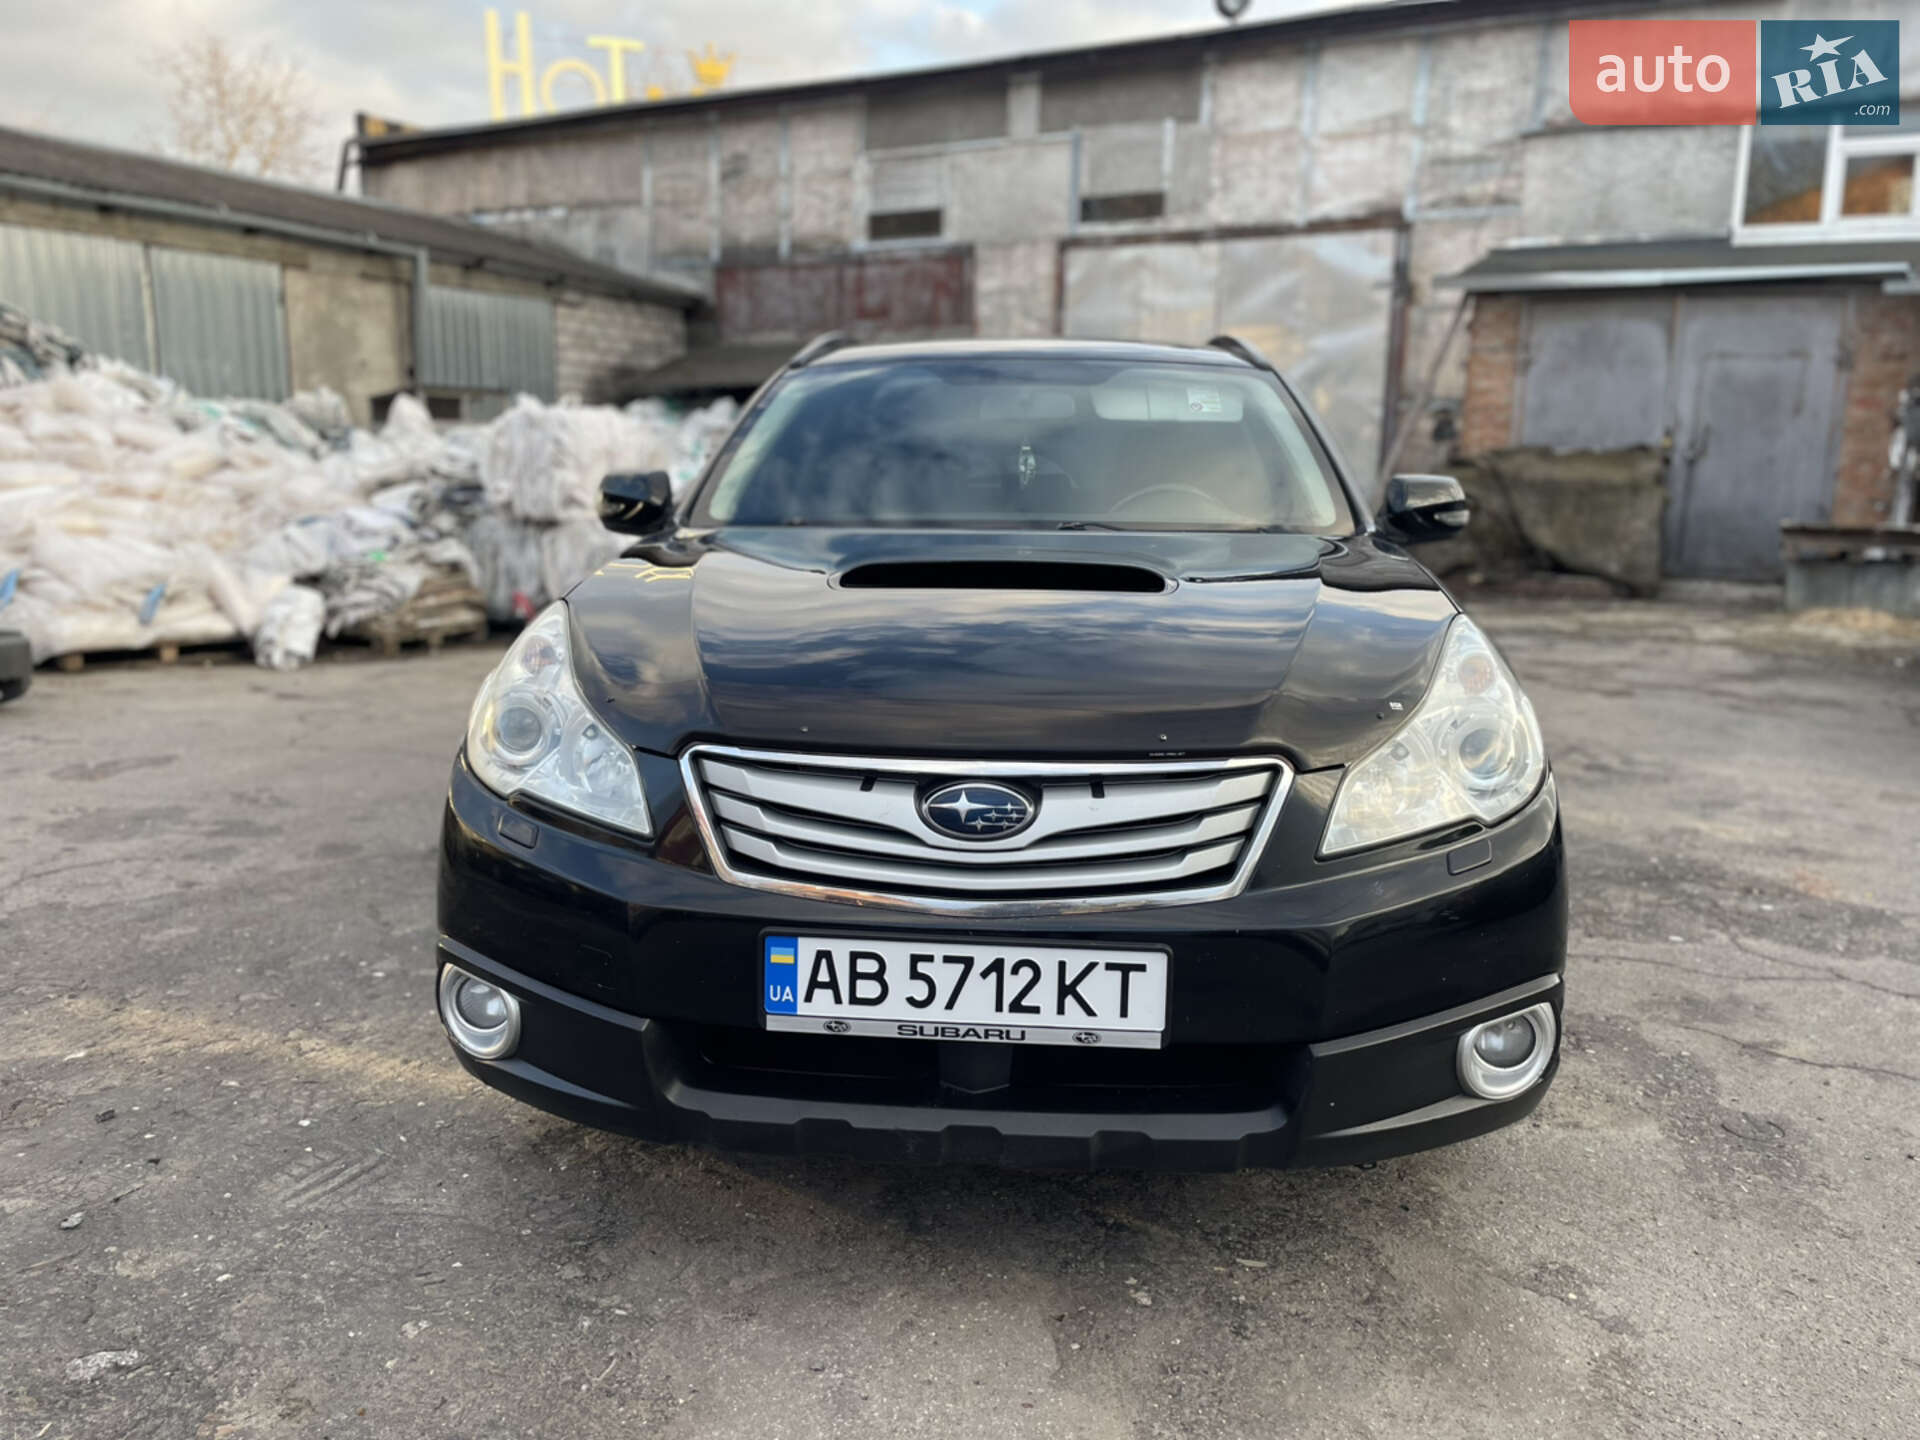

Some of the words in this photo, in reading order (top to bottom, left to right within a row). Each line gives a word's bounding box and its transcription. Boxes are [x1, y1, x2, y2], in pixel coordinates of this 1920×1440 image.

[804, 949, 890, 1006] AB
[905, 953, 1042, 1014] 5712
[1056, 960, 1148, 1018] KT
[769, 985, 794, 1003] UA
[896, 1024, 1026, 1041] SUBARU
